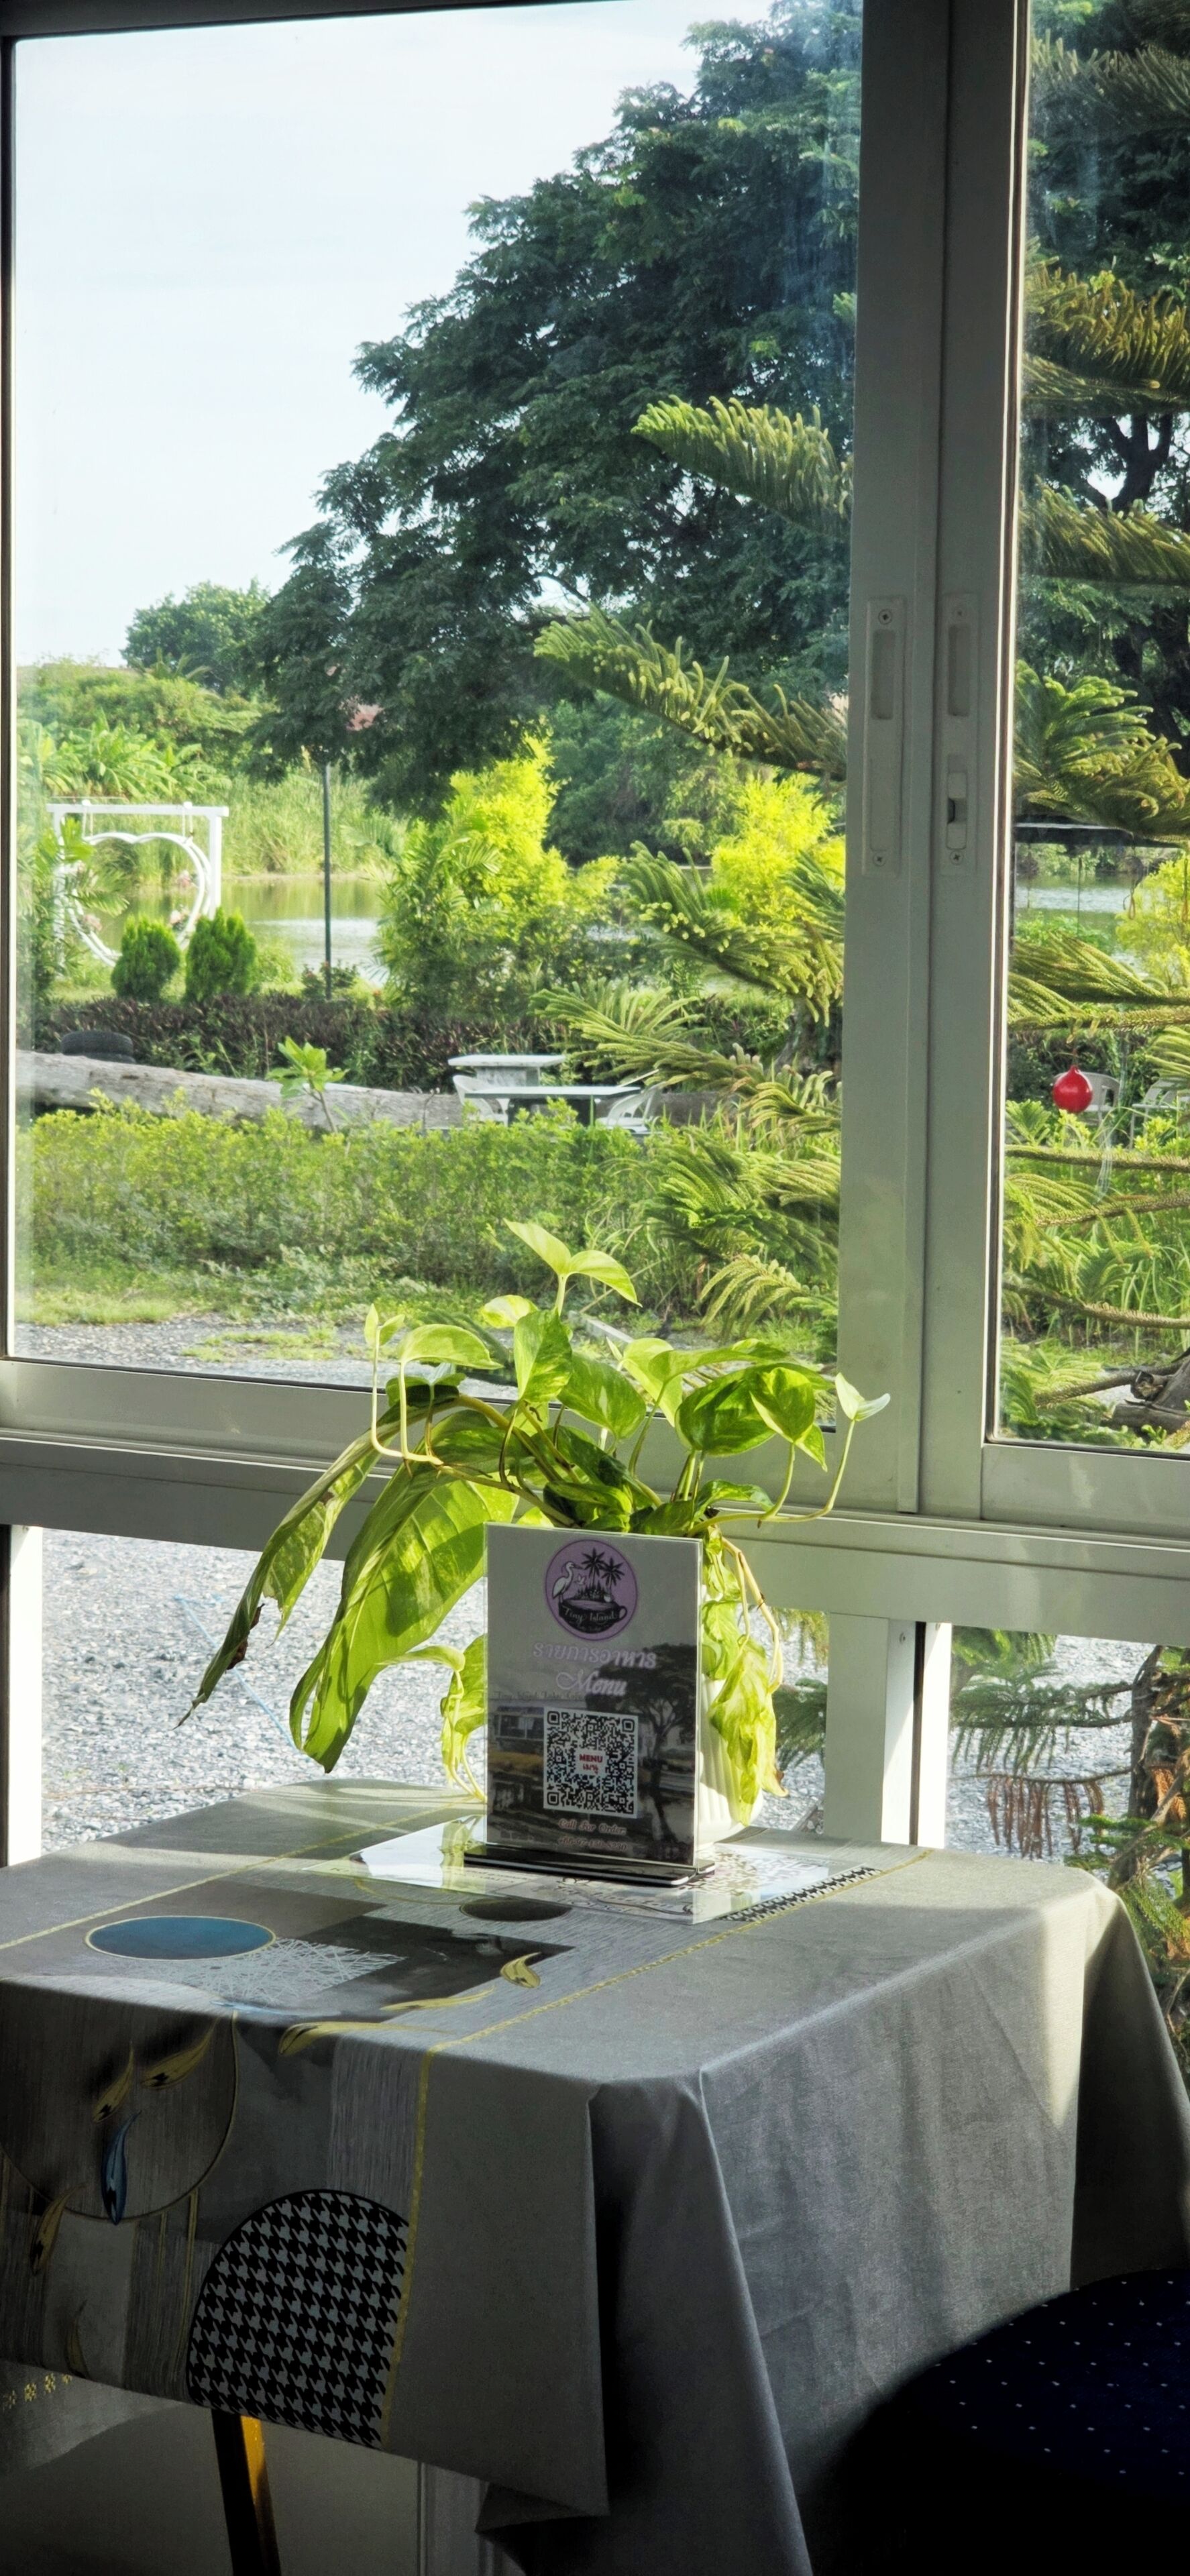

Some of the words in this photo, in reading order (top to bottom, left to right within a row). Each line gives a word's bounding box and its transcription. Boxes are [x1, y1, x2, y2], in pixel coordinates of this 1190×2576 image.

[590, 1611, 616, 1624] Island
[532, 1642, 657, 1669] รายการอาหาร
[556, 1669, 627, 1696] Menu
[579, 1754, 603, 1763] MENU
[558, 1818, 578, 1830] Call
[578, 1820, 597, 1833] For
